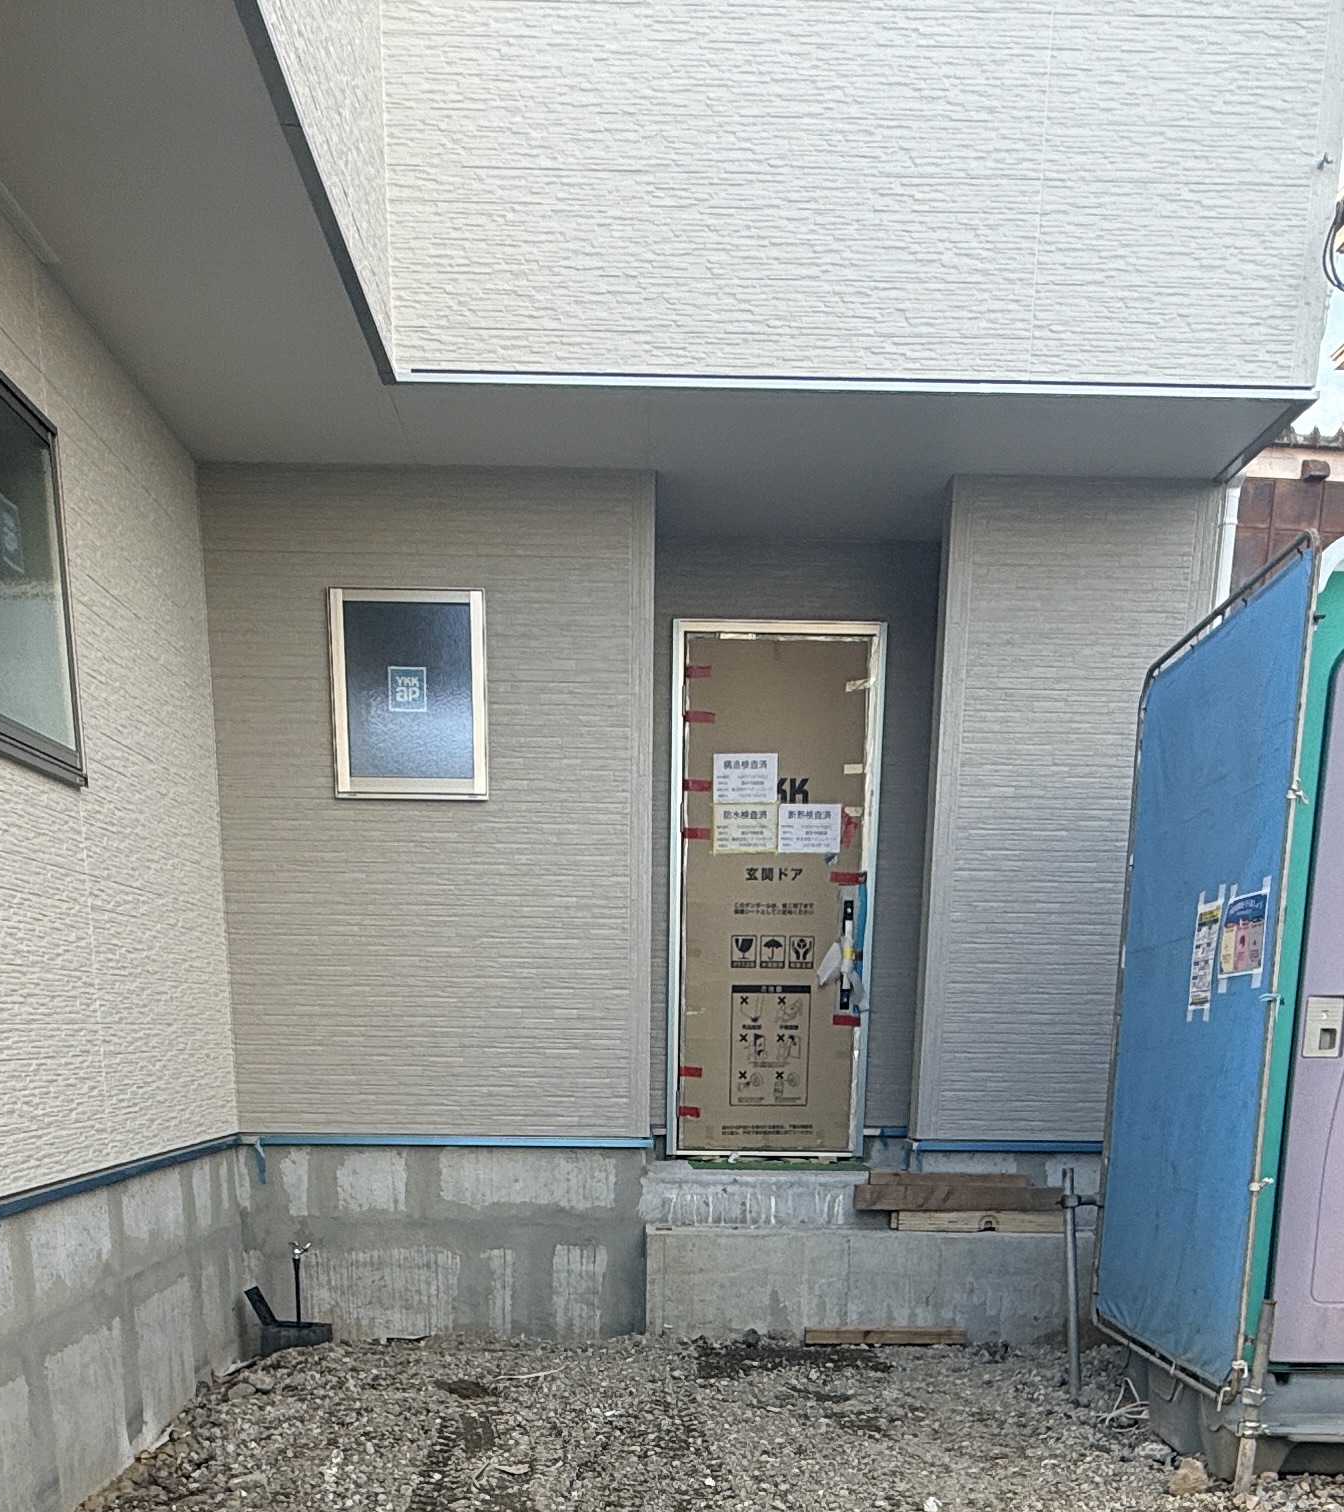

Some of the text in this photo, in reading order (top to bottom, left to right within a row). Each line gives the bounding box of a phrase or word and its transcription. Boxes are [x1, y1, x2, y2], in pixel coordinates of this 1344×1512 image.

[395, 676, 420, 687] YKK
[395, 687, 420, 702] ap
[723, 810, 767, 820] 防水検査済
[787, 810, 832, 820] 断熱検査済
[745, 867, 803, 882] 玄関ドア
